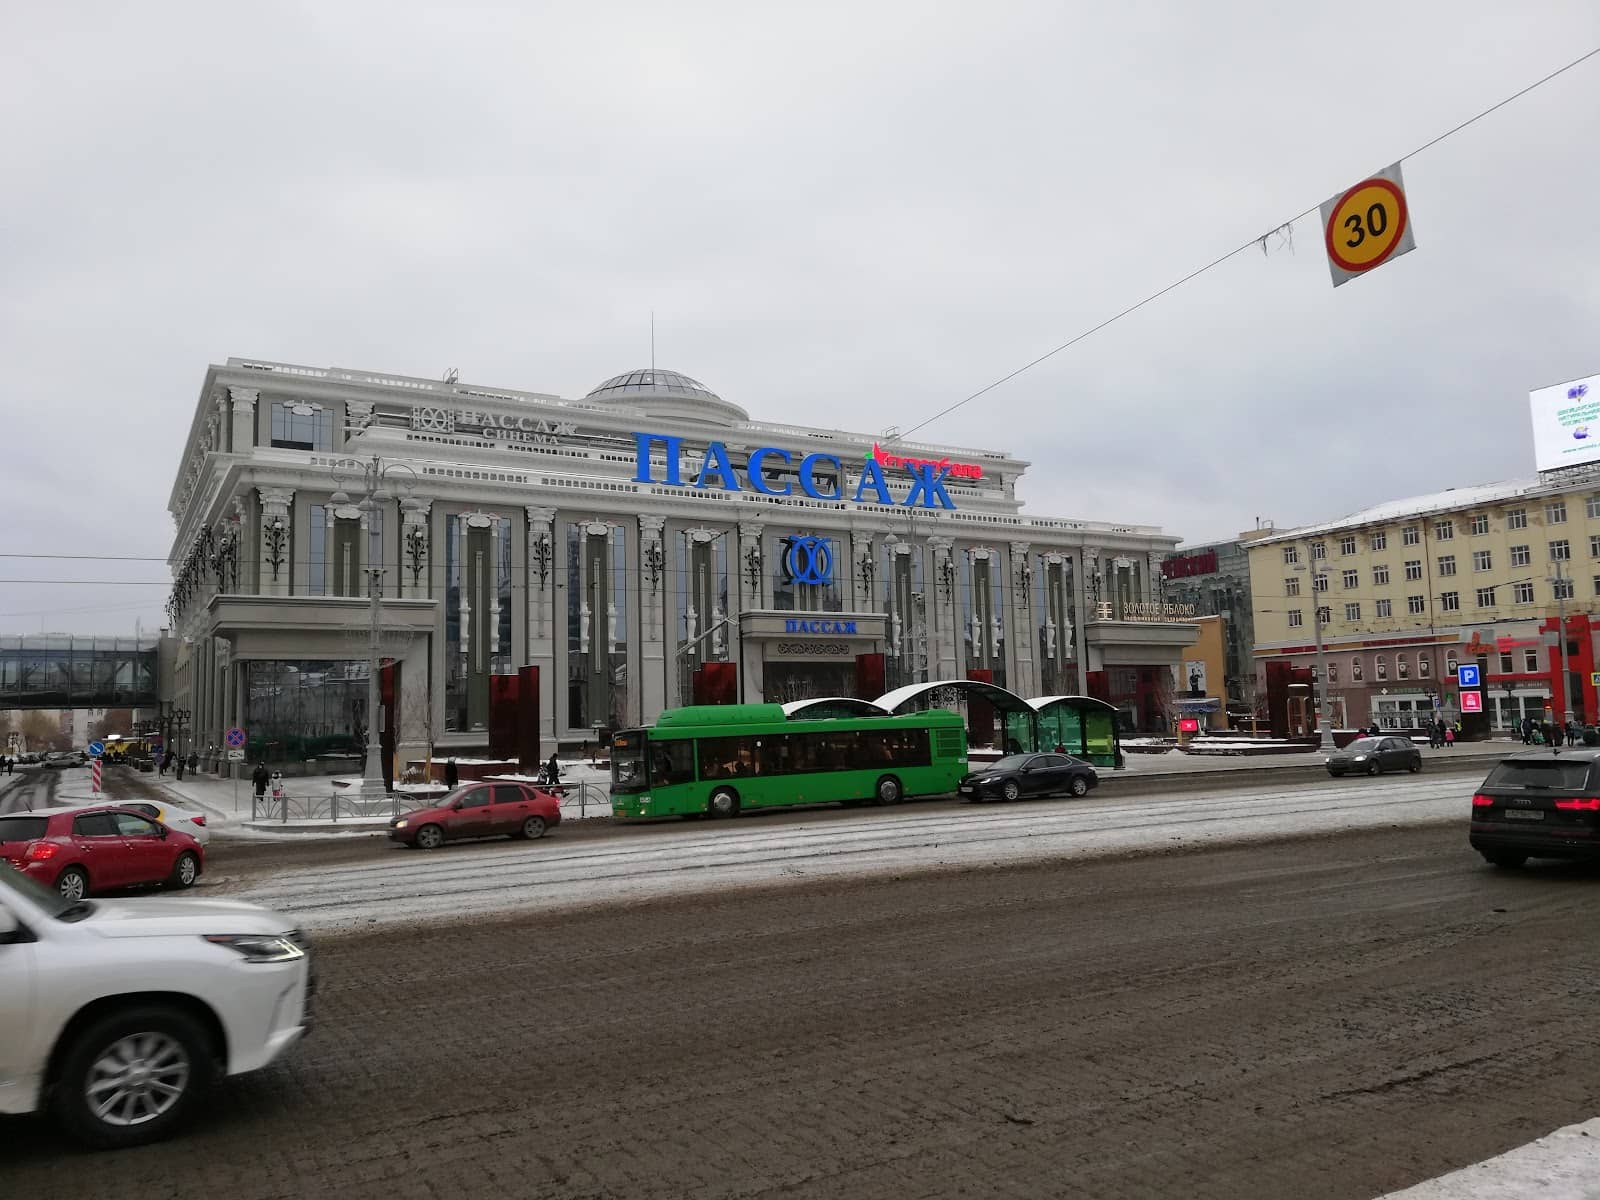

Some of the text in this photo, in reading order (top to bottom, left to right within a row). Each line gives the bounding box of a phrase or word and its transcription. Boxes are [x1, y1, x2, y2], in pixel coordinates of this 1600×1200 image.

[1344, 202, 1387, 248] 30
[457, 410, 577, 436] ПАССАЖ
[482, 428, 560, 445] СИНЕМА
[630, 431, 957, 510] ПАССАЖ
[1124, 602, 1195, 615] ЗОЛОТОЕ ЯБЛОКО
[785, 619, 856, 634] ПАССАЖ
